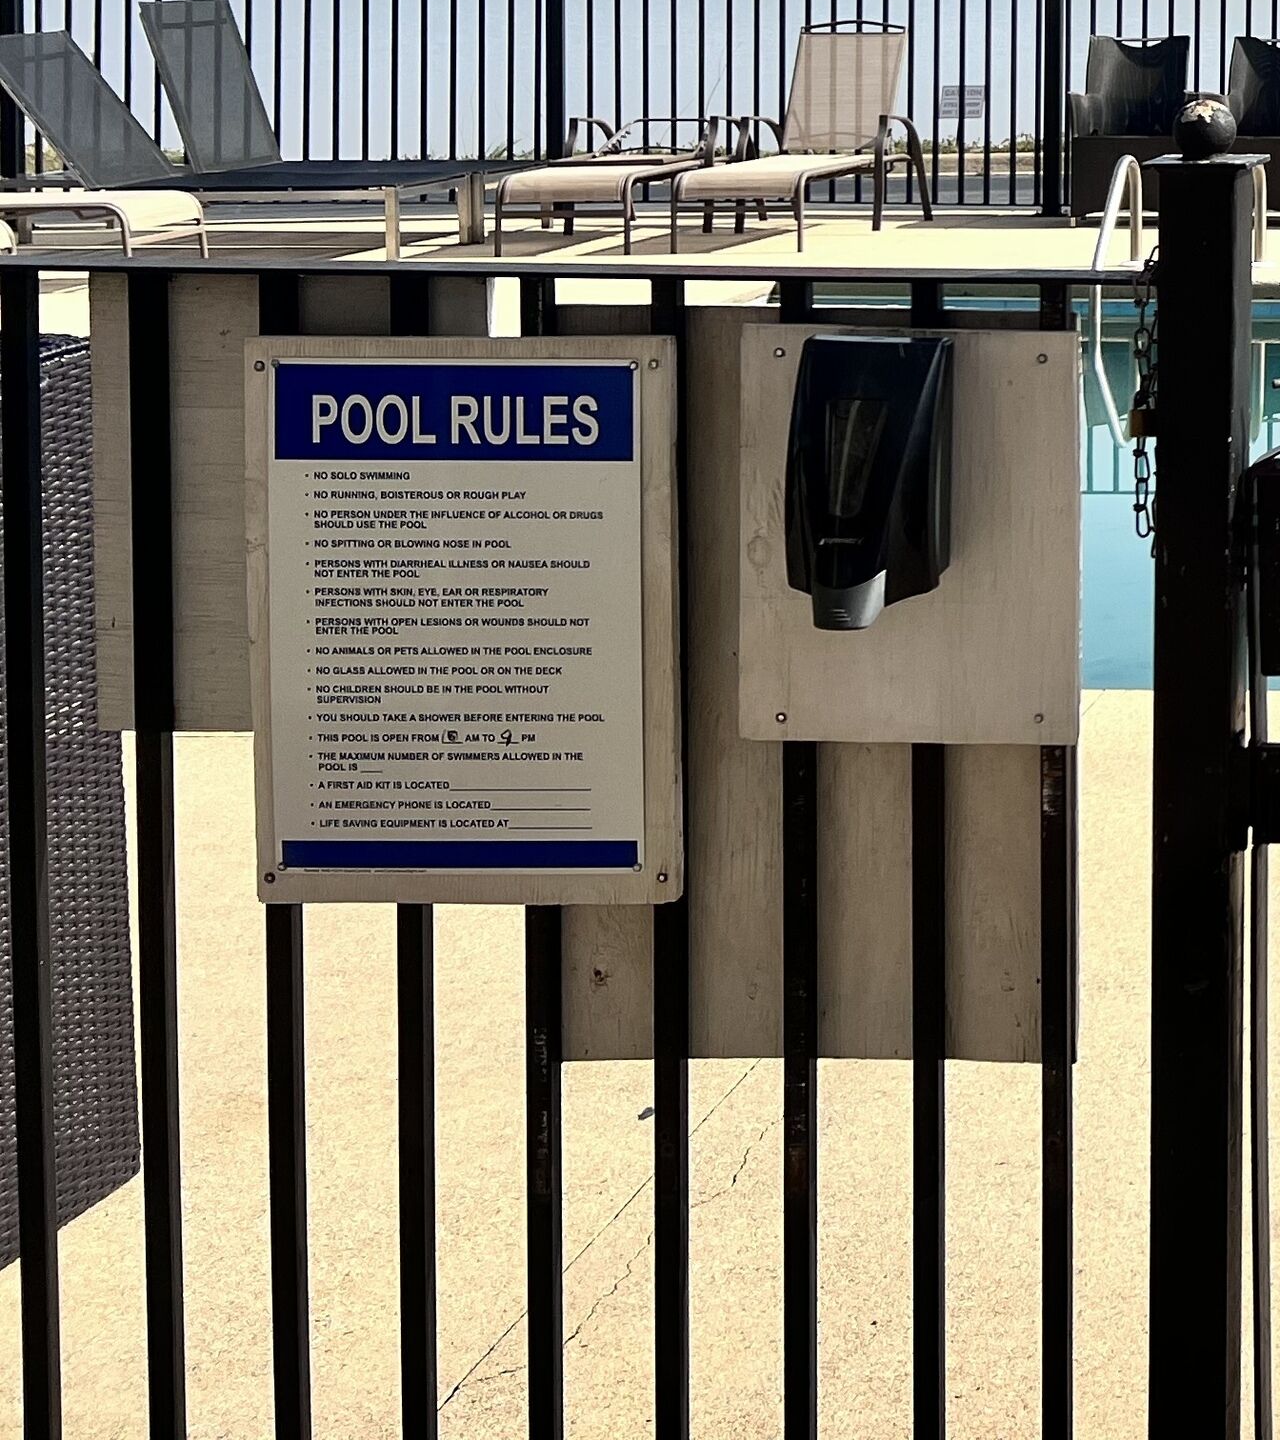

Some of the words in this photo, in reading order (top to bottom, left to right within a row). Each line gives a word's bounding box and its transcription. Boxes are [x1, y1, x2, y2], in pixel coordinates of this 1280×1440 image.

[311, 394, 437, 444] POOL
[450, 395, 600, 446] RULES
[314, 471, 328, 480] NO
[331, 471, 357, 480] SOLO
[360, 471, 410, 480] SWIMMING
[314, 491, 328, 499] NO
[331, 491, 377, 500] RUNNING,
[381, 491, 443, 499] BOISTEROUS
[447, 491, 460, 499] OR
[464, 491, 498, 499] ROUGH
[502, 491, 526, 500] PLAY
[314, 510, 328, 519] NO
[331, 510, 370, 519] PERSON
[373, 510, 407, 519] UNDER
[410, 510, 428, 519] THE
[431, 510, 485, 519] INFLUENCE
[488, 510, 501, 519] OF
[503, 510, 550, 519] ALCOHOL
[553, 510, 567, 519] OR
[570, 510, 603, 519] DRUGS
[315, 520, 353, 529] SHOULD
[357, 520, 375, 529] USE
[378, 520, 397, 529] THE
[400, 520, 427, 529] POOL
[315, 587, 360, 596] PERSONS
[363, 587, 387, 596] WITH
[390, 587, 415, 597] SKIN,
[418, 588, 439, 597] EYE,
[443, 588, 462, 596] EAR
[465, 588, 479, 596] OR
[482, 588, 548, 596] RESPIRATORY
[315, 599, 373, 607] INFECTIONS
[376, 599, 415, 607] SHOULD
[419, 599, 438, 607] NOT
[441, 599, 473, 607] ENTER
[476, 599, 494, 607] THE
[498, 599, 524, 607] POOL
[316, 646, 329, 655] NO
[332, 646, 374, 655] ANIMALS
[378, 646, 391, 655] OR
[394, 646, 418, 655] PETS
[421, 646, 469, 655] ALLOWED
[471, 646, 480, 655] IN
[483, 647, 501, 655] THE
[505, 647, 531, 655] POOL
[534, 647, 592, 655] ENCLOSURE
[316, 666, 330, 675] NO
[333, 666, 365, 675] GLASS
[368, 666, 415, 675] ALLOWED
[418, 666, 427, 675] IN
[430, 666, 448, 675] THE
[452, 666, 478, 675] POOL
[481, 666, 494, 675] OR
[497, 666, 511, 675] ON
[514, 666, 532, 675] THE
[536, 666, 562, 675] DECK
[316, 685, 330, 693] NO
[333, 685, 381, 693] CHILDREN
[384, 685, 423, 693] SHOULD
[427, 685, 439, 693] BE
[443, 685, 451, 693] IN
[454, 685, 473, 693] THE
[476, 685, 502, 694] POOL
[505, 685, 549, 694] WITHOUT
[317, 695, 381, 704] SUPERVISION
[317, 713, 337, 722] YOU
[340, 713, 379, 722] SHOULD
[383, 713, 407, 722] TAKE
[409, 713, 416, 722] A
[419, 713, 461, 722] SHOWER
[464, 714, 502, 722] BEFORE
[506, 714, 553, 722] ENTERING
[557, 714, 575, 722] THE
[579, 714, 604, 722] POOL
[318, 734, 338, 742] THIS
[342, 734, 368, 742] POOL
[371, 734, 379, 742] IS
[382, 734, 408, 742] OPEN
[412, 734, 439, 742] FROM
[465, 734, 479, 742] AM
[482, 734, 495, 742] TO
[522, 734, 535, 742] PM
[318, 752, 336, 761] THE
[339, 752, 385, 761] MAXIMUM
[388, 752, 429, 761] NUMBER
[432, 752, 444, 761] OF
[448, 752, 500, 761] SWIMMERS
[502, 752, 549, 761] ALLOWED
[553, 752, 561, 761] IN
[564, 752, 583, 761] THE
[319, 763, 346, 772] POOL
[349, 763, 357, 772] IS
[318, 781, 325, 790] A
[328, 781, 354, 790] FIRST
[357, 781, 372, 790] AID
[376, 781, 390, 790] KIT
[393, 781, 402, 790] IS
[405, 781, 449, 790] LOCATED
[319, 800, 332, 809] AN
[335, 801, 395, 809] EMERGENCY
[398, 801, 431, 809] PHONE
[434, 801, 443, 809] IS
[446, 801, 490, 809] LOCATED
[320, 820, 339, 828] LIFE
[343, 820, 377, 828] SAVING
[381, 820, 435, 828] EQUIPMENT
[439, 820, 447, 828] IS
[450, 820, 494, 828] LOCATED
[497, 820, 509, 828] AT
